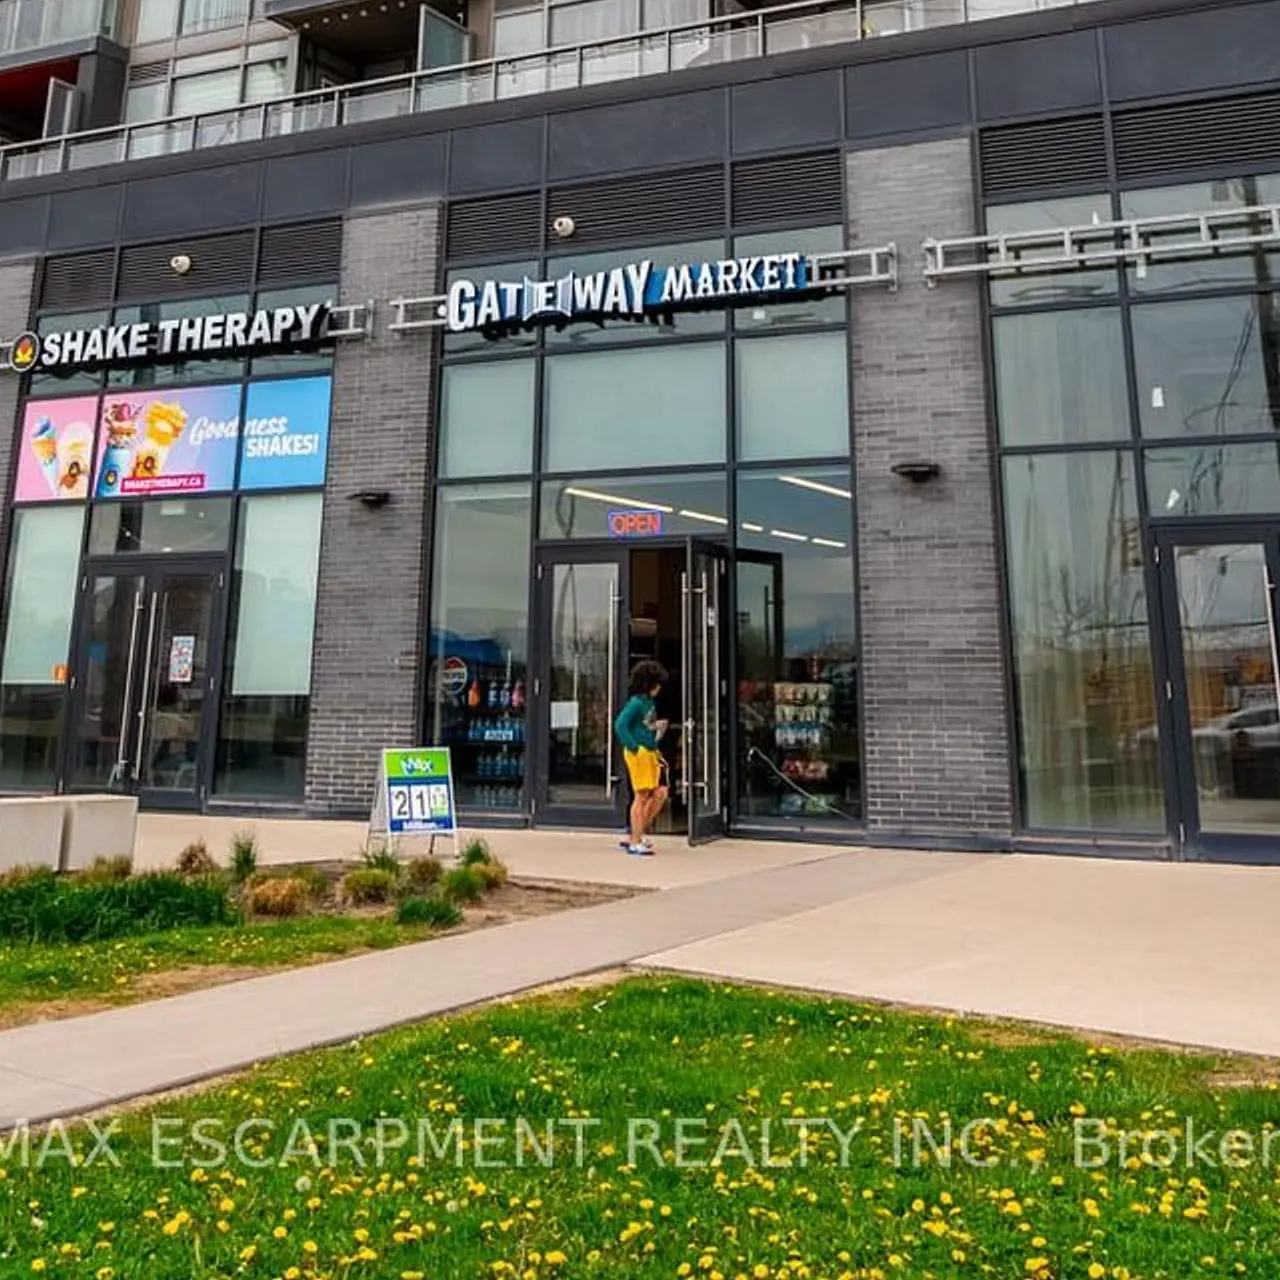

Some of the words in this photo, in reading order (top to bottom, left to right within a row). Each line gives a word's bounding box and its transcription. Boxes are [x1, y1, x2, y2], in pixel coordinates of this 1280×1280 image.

[449, 260, 654, 332] GATEWAY
[661, 253, 801, 302] MARKET
[41, 321, 150, 366] SHAKE
[160, 304, 320, 353] THERAPY
[246, 433, 319, 458] SHAKES!
[611, 514, 660, 535] OPEN
